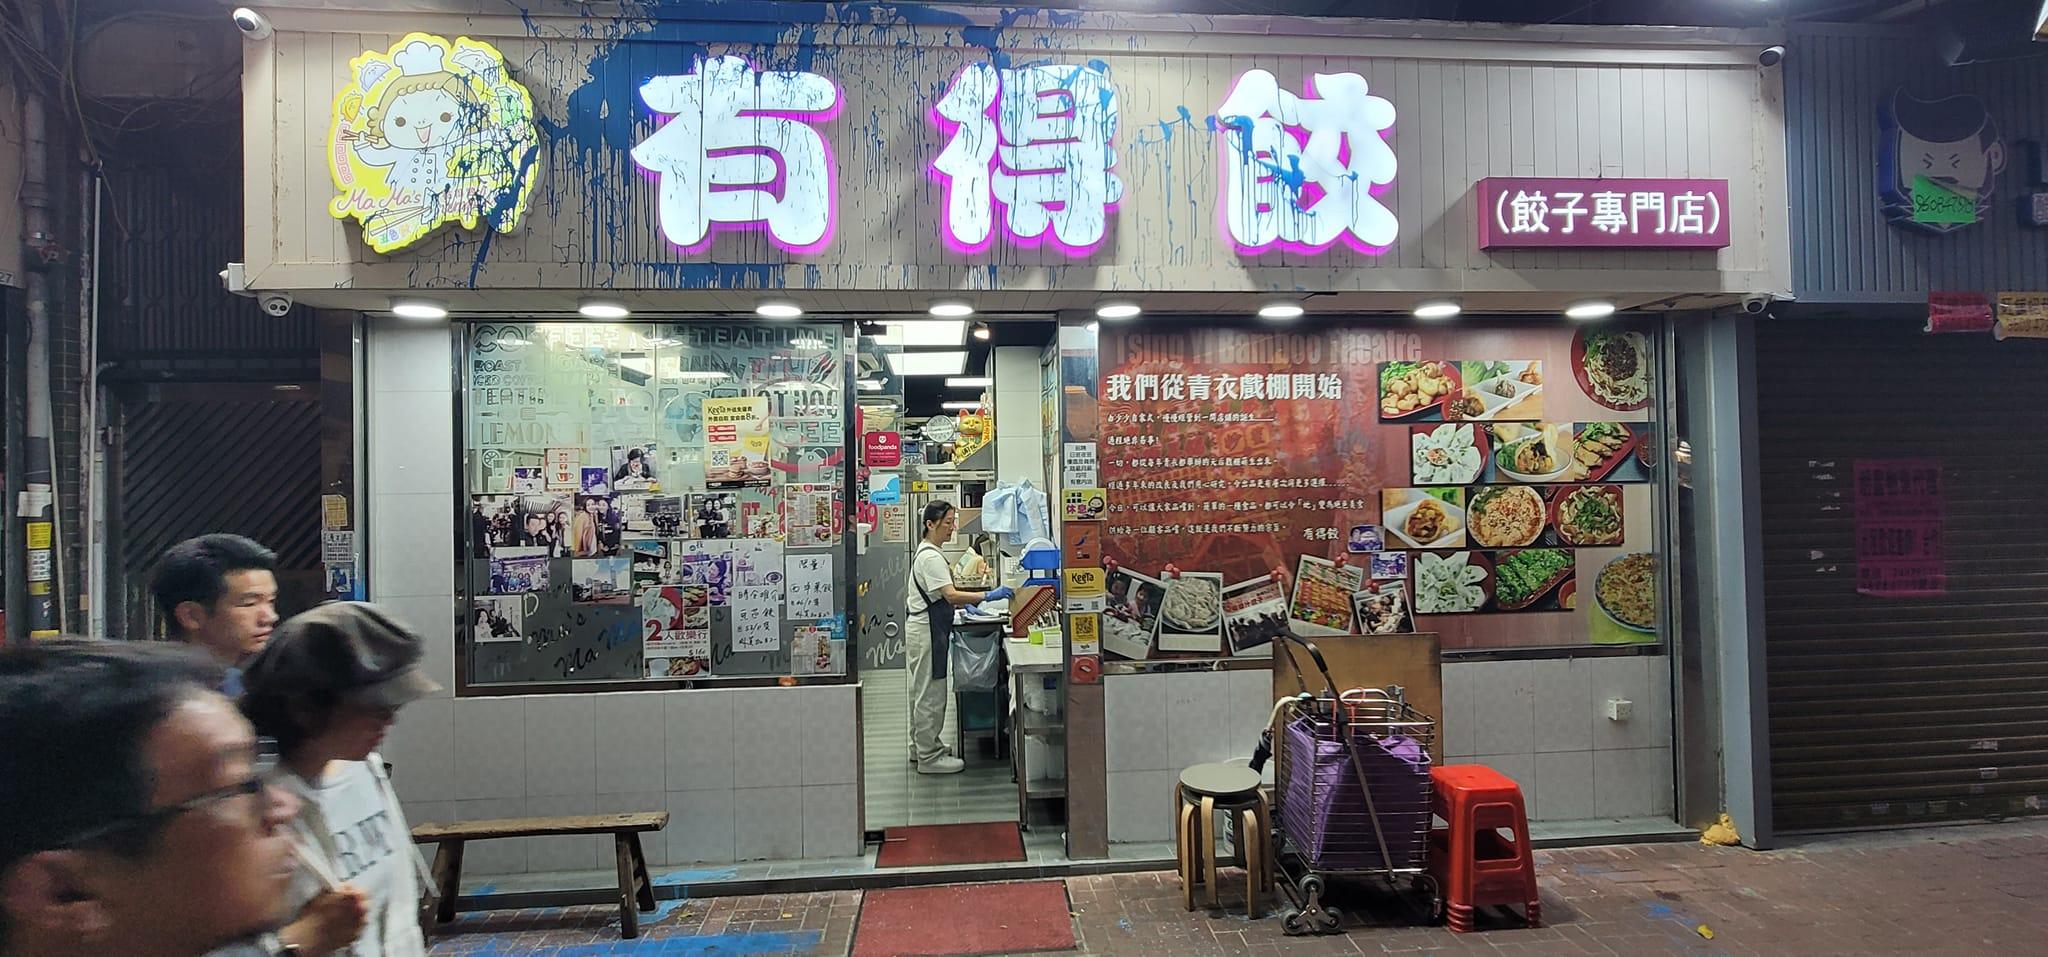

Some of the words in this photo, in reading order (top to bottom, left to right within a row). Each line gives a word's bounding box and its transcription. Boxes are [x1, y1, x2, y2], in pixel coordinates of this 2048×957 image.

[337, 189, 375, 211] Ma
[379, 188, 421, 207] Ma's
[1496, 190, 1720, 234] (餃子專門店)
[1218, 329, 1321, 364] Bamboo
[1329, 329, 1422, 364] Theatre
[1107, 373, 1341, 400] 我們從青衣戲棚開始
[868, 443, 898, 452] foodpanda
